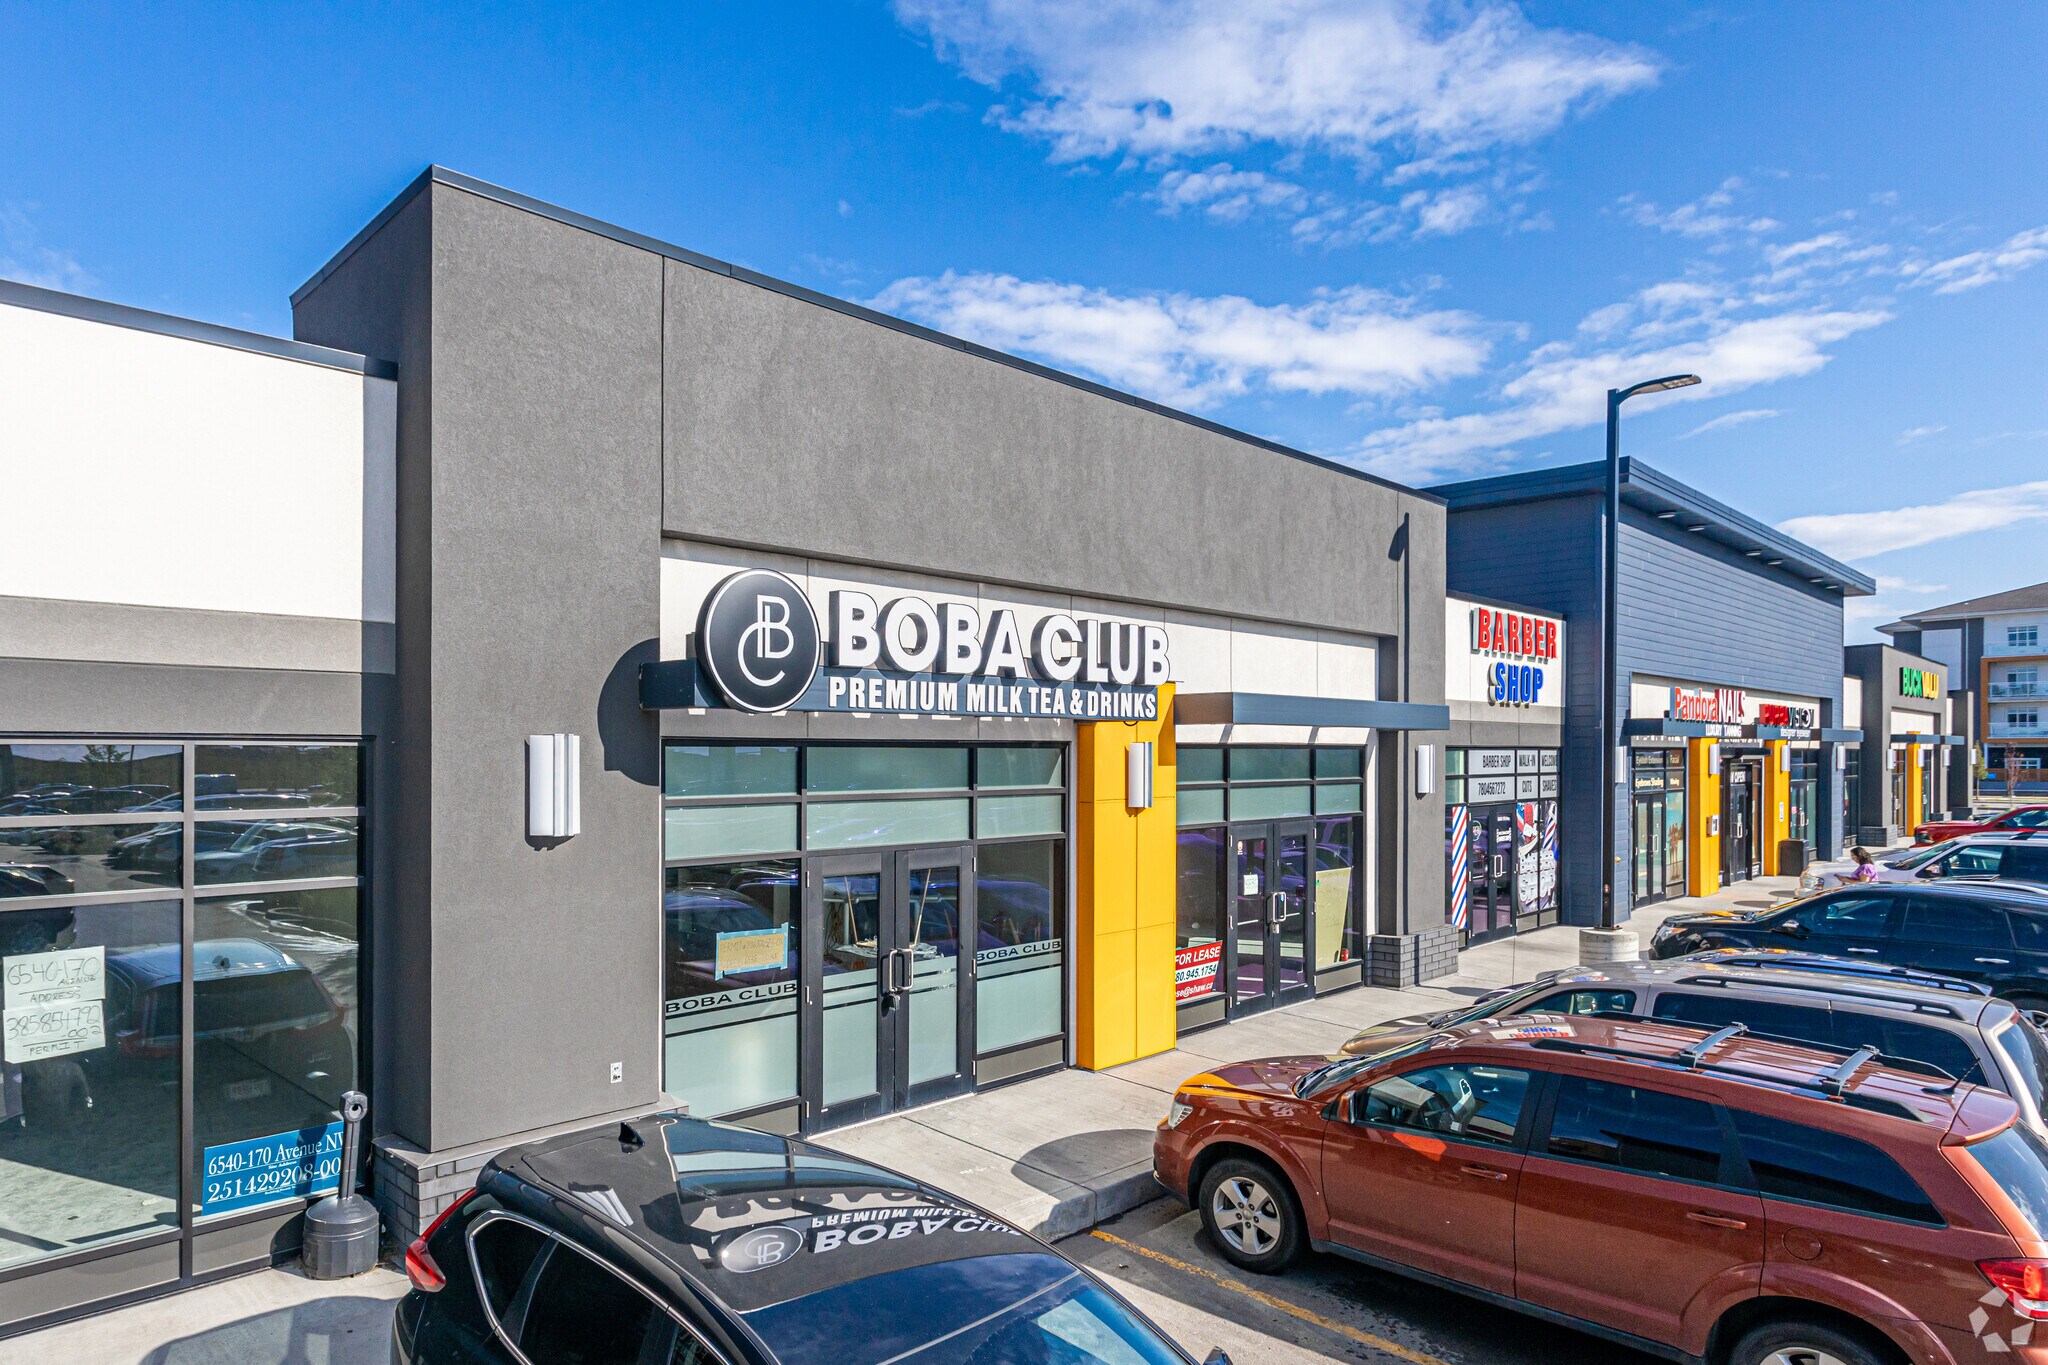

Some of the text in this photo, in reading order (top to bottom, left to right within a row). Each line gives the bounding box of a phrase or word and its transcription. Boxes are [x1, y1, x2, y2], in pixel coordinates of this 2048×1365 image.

[832, 590, 1171, 685] BOBA CLUB
[1475, 607, 1558, 659] BARBER
[1491, 662, 1543, 703] SHOP
[829, 676, 1156, 718] PREMIUM MILK TEA & DRINKS
[1673, 686, 1746, 724] Pandora NAILS
[1482, 755, 1512, 768] BARBER SHOP
[1519, 755, 1536, 767] WALK-IN
[1521, 780, 1533, 793] CUTS
[977, 941, 1061, 961] BOBA CLUB
[1175, 946, 1221, 965] FOR LEASE
[7, 957, 101, 985] 6540-170
[30, 990, 81, 1002] ADDRESS
[665, 984, 797, 1013] BOBA CLUB
[29, 1040, 85, 1056] PERMIT
[208, 1147, 271, 1175] 6540-170
[275, 1141, 322, 1162] Avenue
